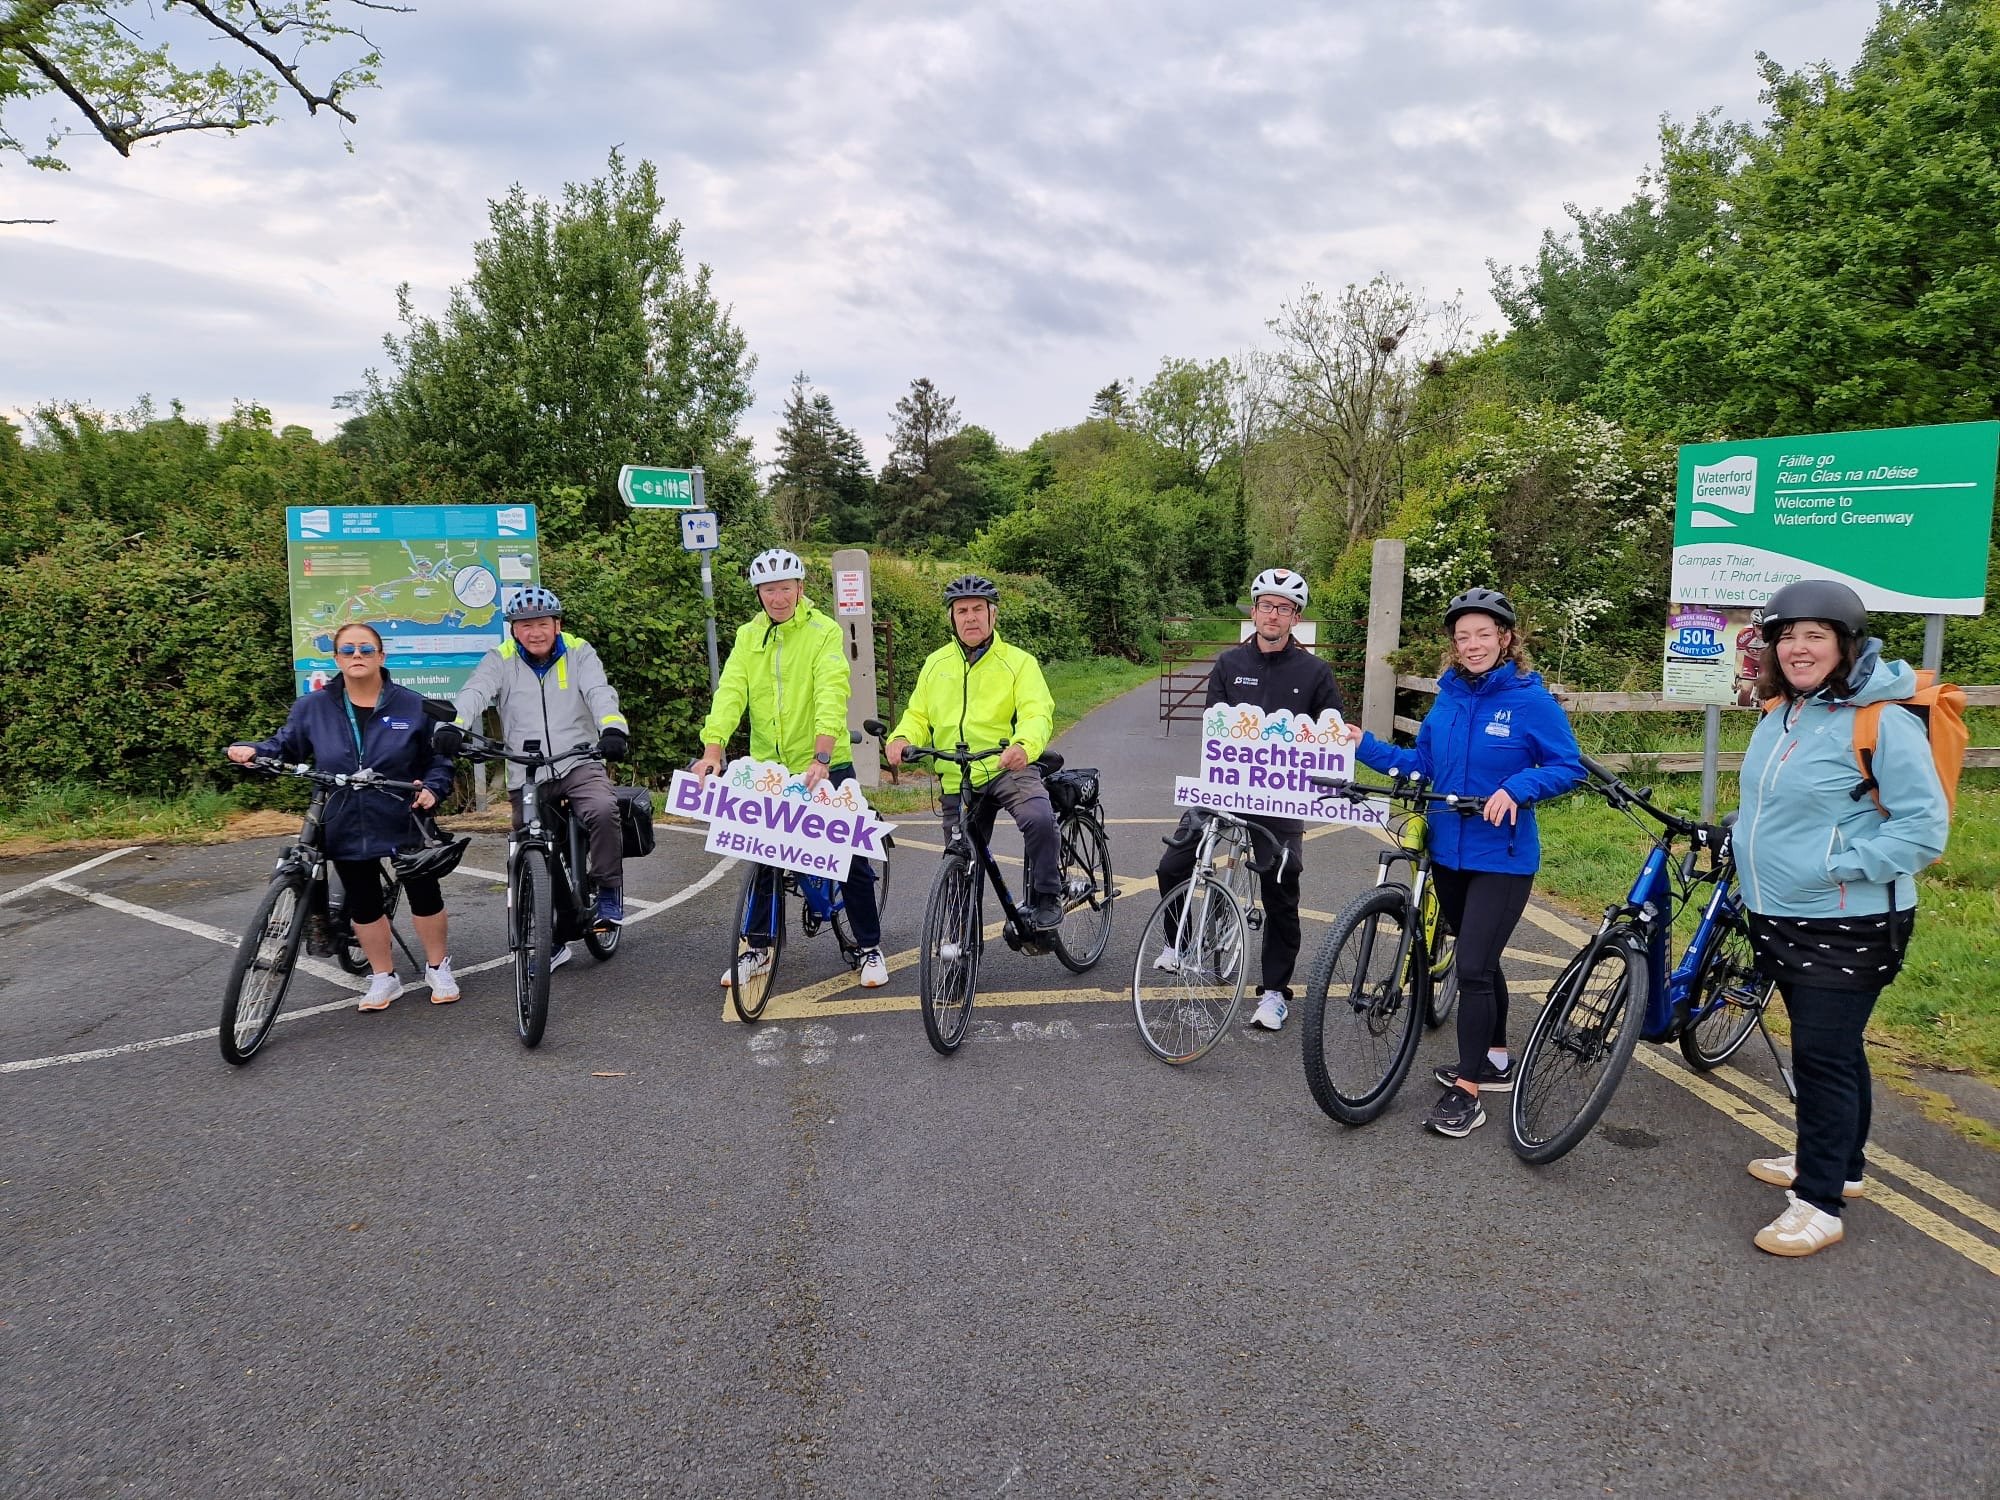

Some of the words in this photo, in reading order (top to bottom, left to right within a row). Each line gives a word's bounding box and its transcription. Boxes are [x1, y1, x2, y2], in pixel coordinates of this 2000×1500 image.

[1777, 454, 1814, 467] Fáilte
[1817, 455, 1835, 468] go
[1698, 469, 1753, 483] Waterford
[1776, 472, 1807, 484] Rian
[1811, 469, 1842, 482] Glas
[1845, 471, 1863, 481] na
[1866, 465, 1919, 480] nDéise
[1697, 484, 1751, 497] Greenway
[1775, 496, 1835, 509] Welcome
[1839, 496, 1852, 507] to
[1774, 512, 1837, 525] Waterford
[1841, 511, 1914, 527] Greenway
[1678, 554, 1722, 567] Campas
[1727, 555, 1755, 567] Thiar,
[1711, 570, 1727, 582] I.T.
[1730, 571, 1762, 582] Phort
[1764, 570, 1801, 585] Láirge
[1679, 587, 1711, 599] W.I.T.
[1715, 588, 1744, 600] West
[1683, 630, 1712, 645] 50k
[1671, 643, 1700, 655] CHARITY
[1701, 645, 1722, 654] CYCLE
[401, 678, 415, 687] gan
[1205, 739, 1345, 772] Seachtain
[1209, 766, 1240, 785] na
[1177, 786, 1385, 824] #SeachtainnaRothar
[676, 778, 877, 851] BikeWeek
[716, 831, 840, 874] #BikeWeek
